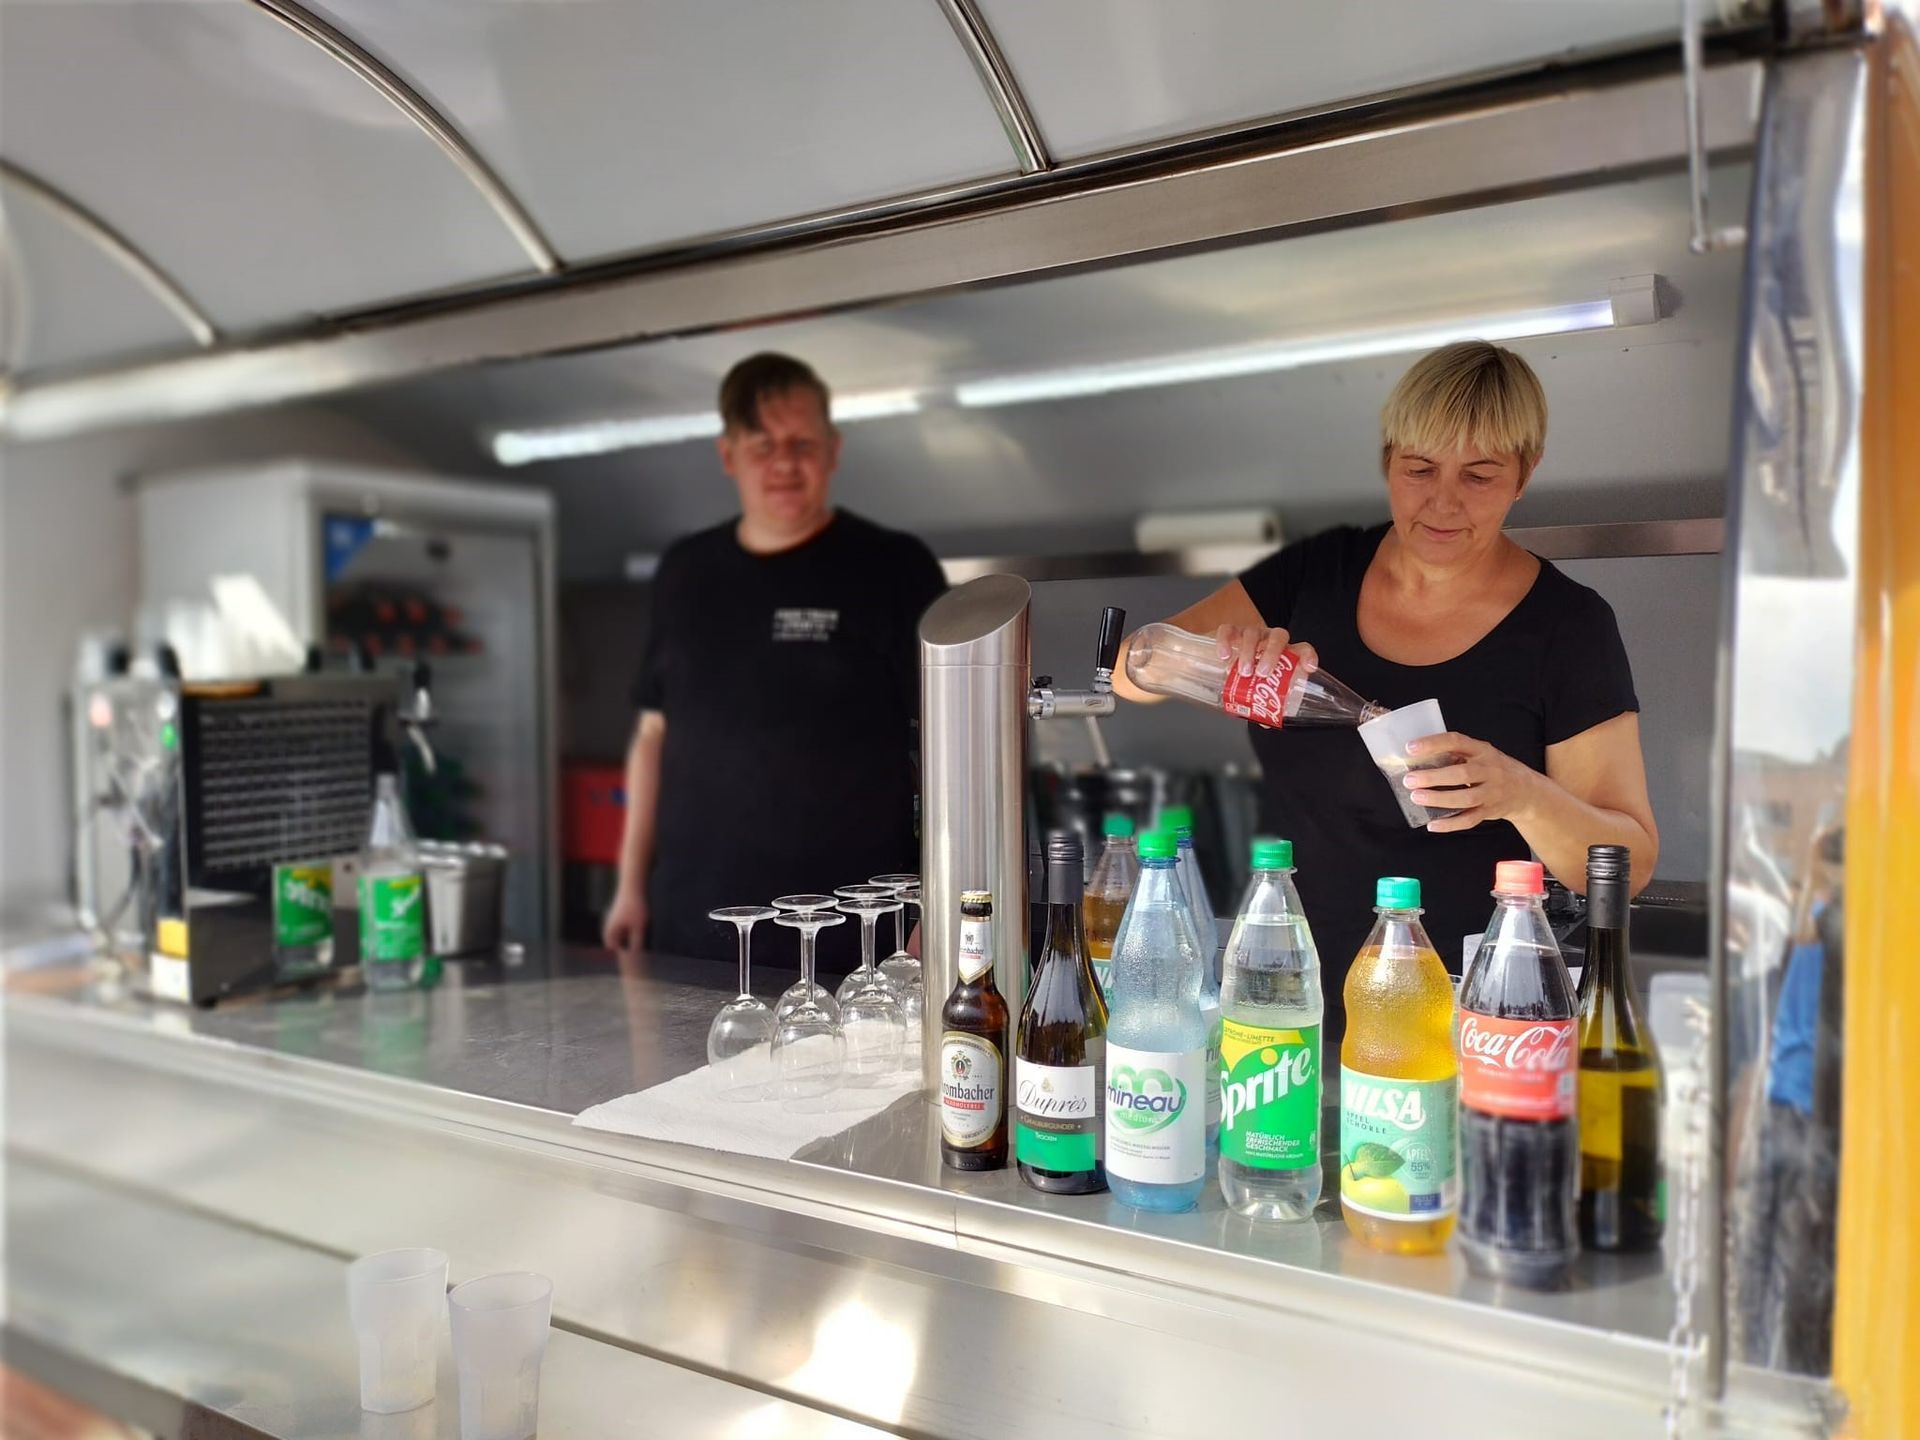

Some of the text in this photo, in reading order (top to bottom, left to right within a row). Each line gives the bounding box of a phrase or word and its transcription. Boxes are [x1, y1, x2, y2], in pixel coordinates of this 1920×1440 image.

[1461, 1018, 1574, 1070] Coca-Cola
[943, 1082, 996, 1100] rombacher
[1108, 1085, 1182, 1113] mineau
[1220, 1047, 1313, 1131] Sprite
[1344, 1080, 1423, 1122] VILSA
